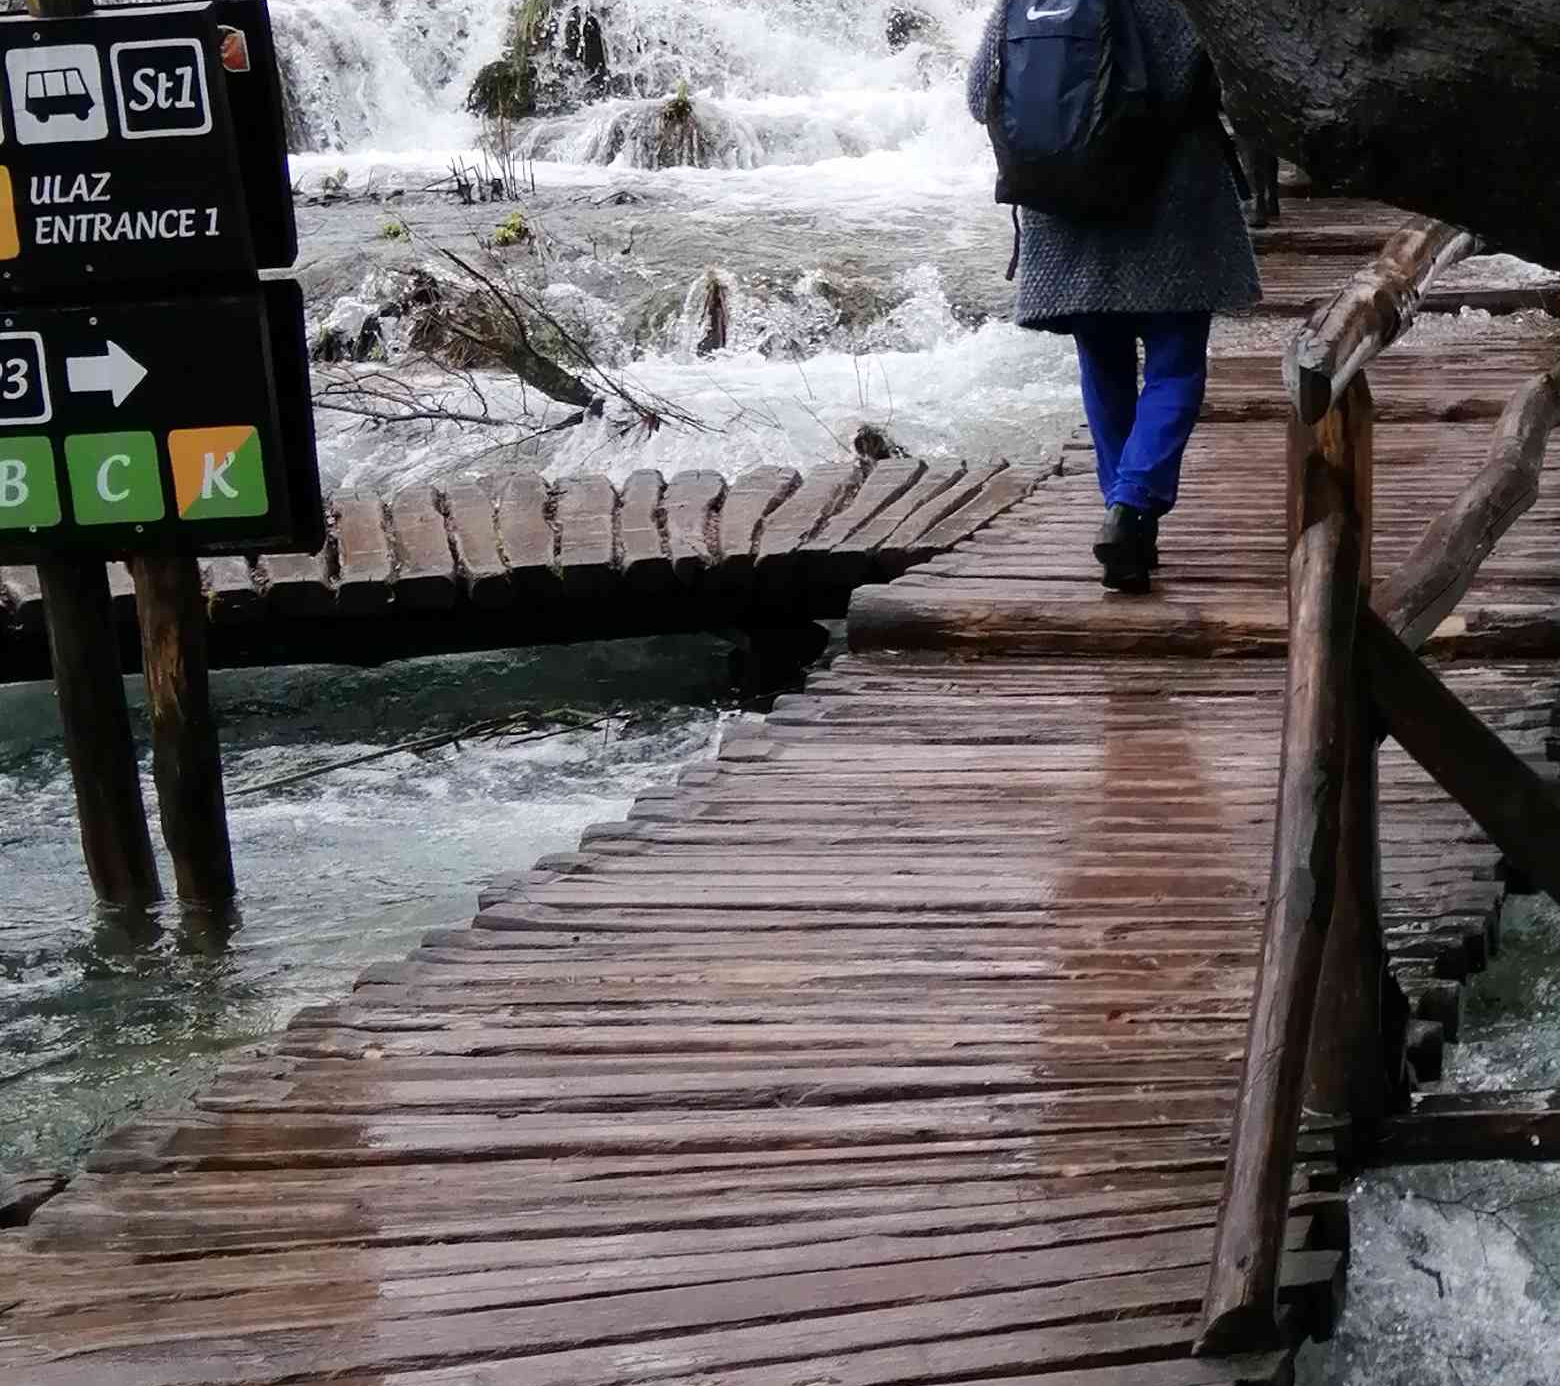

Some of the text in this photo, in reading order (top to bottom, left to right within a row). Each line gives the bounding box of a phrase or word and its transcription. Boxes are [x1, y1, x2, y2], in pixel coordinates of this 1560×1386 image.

[128, 65, 196, 112] St1
[30, 171, 112, 205] ULAZ
[35, 207, 220, 245] ENTRANCE 1
[0, 357, 28, 400] 3
[0, 452, 239, 507] B C K
